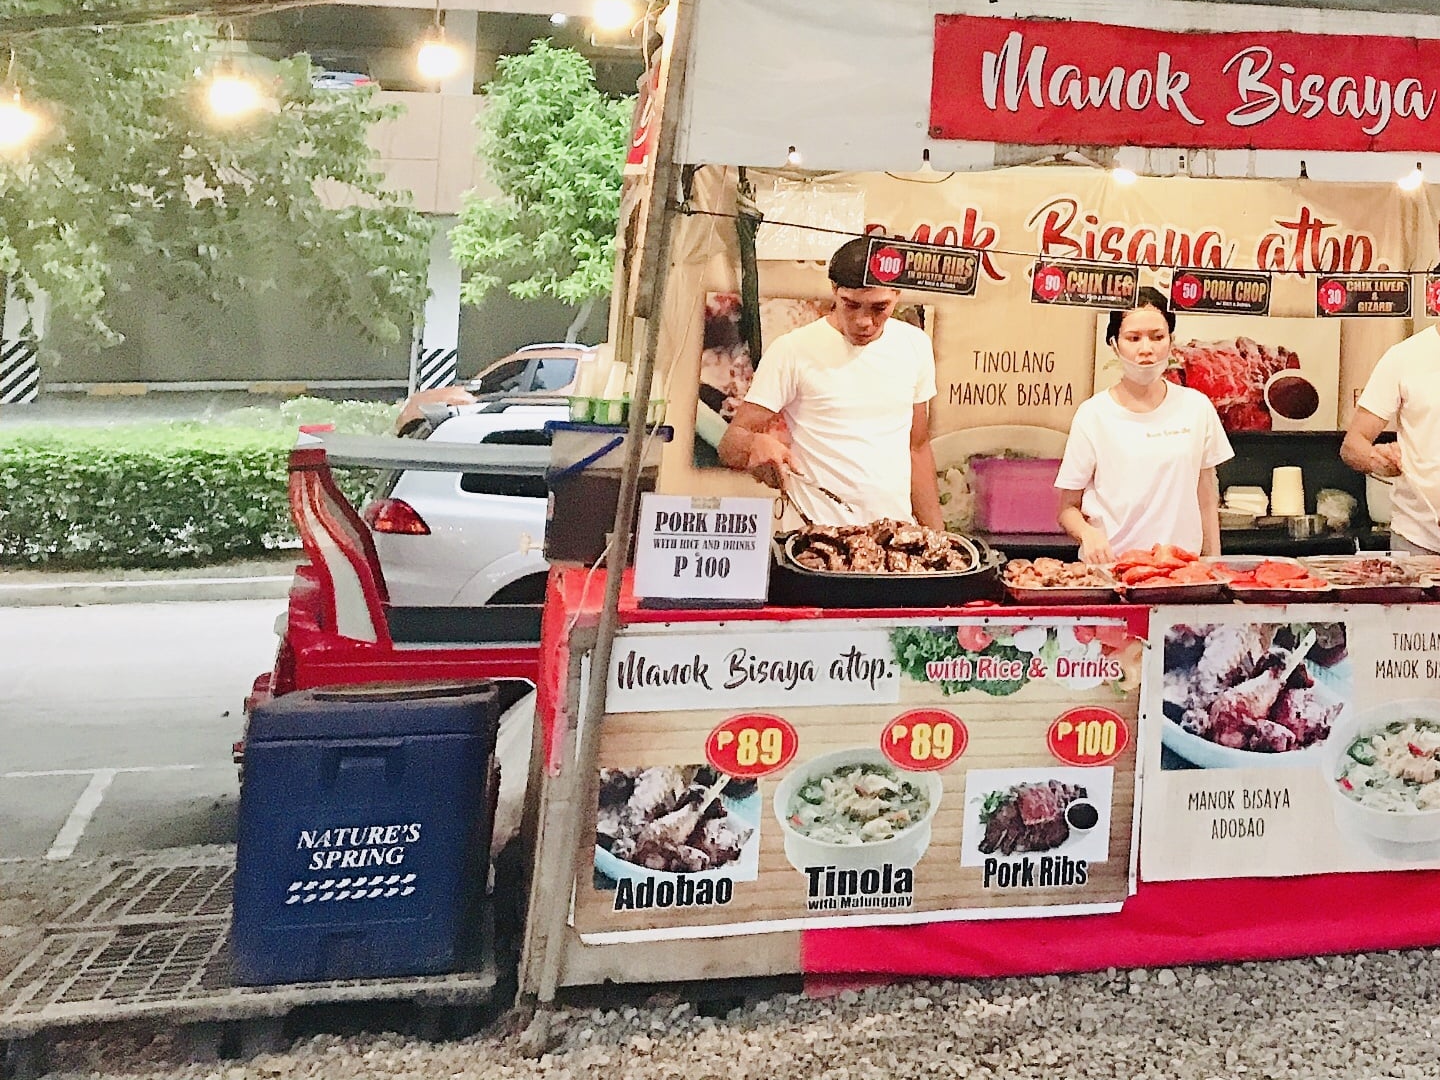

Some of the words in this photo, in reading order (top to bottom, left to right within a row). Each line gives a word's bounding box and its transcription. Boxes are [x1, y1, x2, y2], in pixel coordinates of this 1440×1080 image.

[982, 31, 1204, 125] Manok
[1222, 46, 1436, 136] Bisaya
[905, 251, 941, 273] PORK
[942, 255, 974, 278] RIBS
[1067, 270, 1104, 294] CHIX
[1203, 279, 1234, 300] PORK
[1235, 281, 1266, 302] CHOP
[1346, 281, 1372, 292] CHIX
[1375, 281, 1404, 292] LIVER
[973, 350, 1055, 373] TINOLANG
[950, 383, 1007, 406] MANOK
[1017, 383, 1073, 406] BISAYA
[655, 511, 708, 532] PORK
[714, 513, 758, 534] RIBS
[653, 538, 677, 549] WITH
[680, 539, 700, 549] RICE
[702, 540, 720, 550] AND
[723, 540, 756, 551] DRINKS
[695, 556, 731, 578] 100
[618, 650, 713, 691] Manok
[723, 648, 819, 690] Bisaya
[829, 645, 893, 691] atbp.
[927, 657, 970, 679] with
[978, 658, 1021, 679] Rice
[1029, 658, 1047, 678] &
[1057, 657, 1119, 678] Drinks
[1375, 660, 1418, 679] MANOK
[1188, 790, 1235, 810] MANOK
[1243, 788, 1290, 809] BISAYA
[297, 823, 421, 850] NATURE'S
[1212, 817, 1264, 839] ADOBAO
[309, 847, 405, 870] SPRING
[805, 863, 913, 897] Tinola
[984, 858, 1034, 888] Pork
[1040, 856, 1087, 887] Ribs
[615, 875, 732, 910] Adobao
[808, 896, 837, 910] with
